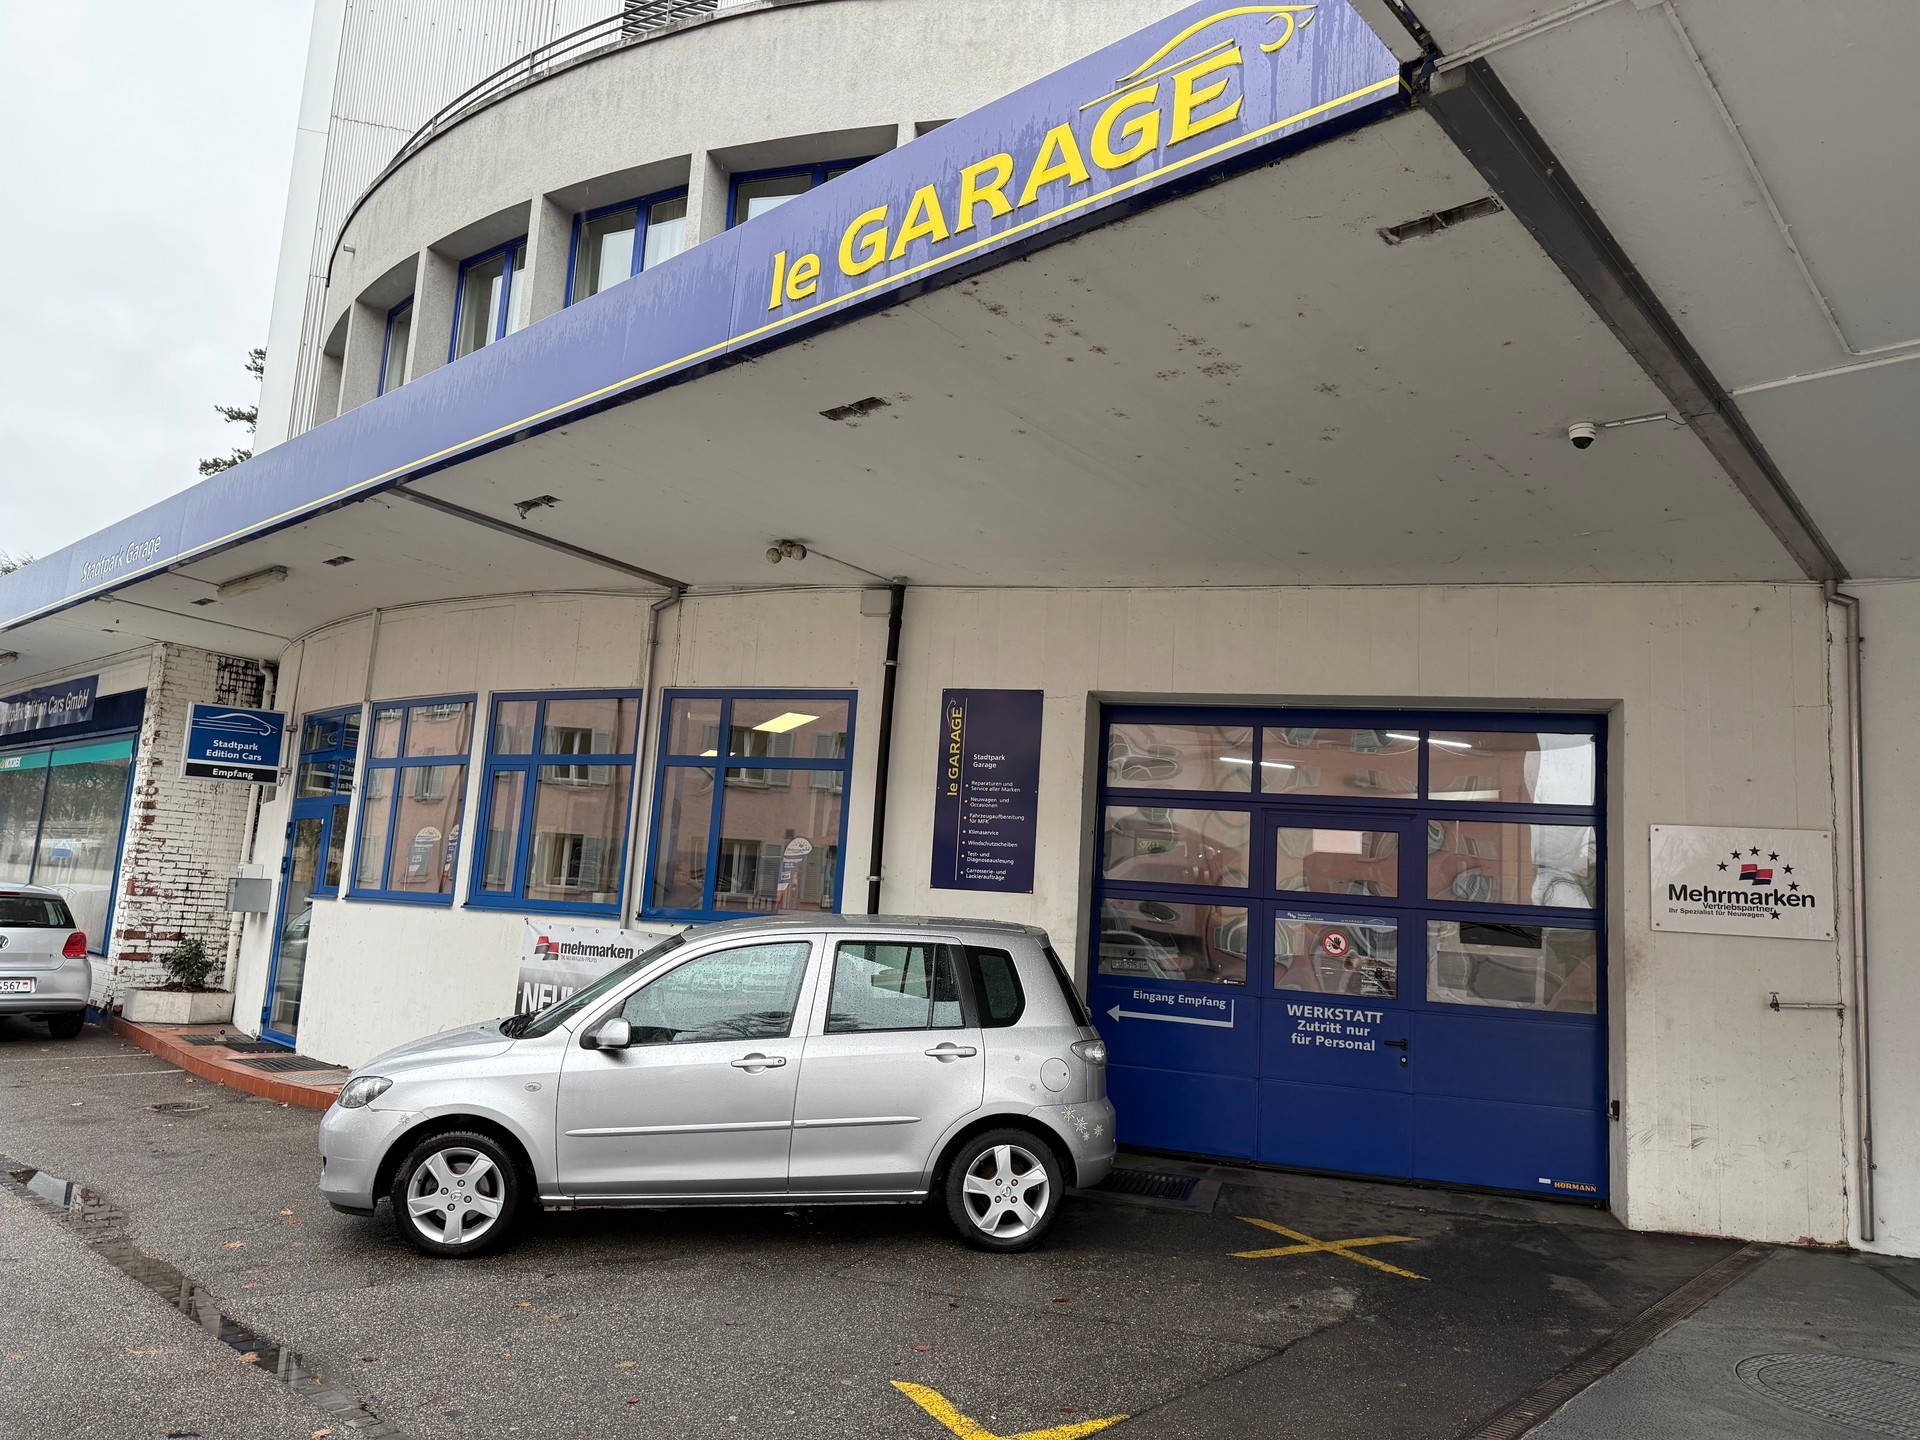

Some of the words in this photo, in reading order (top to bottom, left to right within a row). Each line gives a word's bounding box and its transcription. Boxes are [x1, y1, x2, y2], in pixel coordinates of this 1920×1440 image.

[768, 250, 820, 310] le
[838, 45, 1245, 277] GARAGE
[81, 545, 124, 582] Stadtpark
[126, 535, 161, 564] Garage
[48, 696, 64, 715] Cars
[65, 688, 90, 711] GmbH
[213, 739, 259, 751] Stadtpark
[948, 706, 963, 780] GARAGE
[206, 749, 240, 759] Edition
[242, 752, 262, 761] Cars
[973, 753, 1006, 762] Stadtpark
[972, 761, 997, 769] Garage
[212, 768, 255, 780] Empfang
[947, 783, 959, 796] le
[969, 812, 1025, 821] Fahrzeugaufbereitung
[967, 840, 1018, 848] Windschutzscheiben
[966, 856, 1015, 865] Diagnoseauslesung
[965, 873, 1005, 881] Lackieraufträge
[1668, 883, 1816, 909] Mehrmarken
[1680, 908, 1714, 916] Spezialist
[1727, 910, 1765, 919] Neuwagen
[1702, 901, 1775, 913] Vertriebspartner
[560, 940, 635, 960] mehrmarken
[521, 981, 581, 1014] NEU
[1133, 990, 1175, 1005] Eingang
[1178, 994, 1227, 1010] Empfang
[1286, 1004, 1384, 1024] WERKSTATT
[1297, 1019, 1342, 1034] Zutritt
[1346, 1026, 1371, 1037] nur
[1291, 1032, 1312, 1045] für
[1315, 1035, 1376, 1052] Personal
